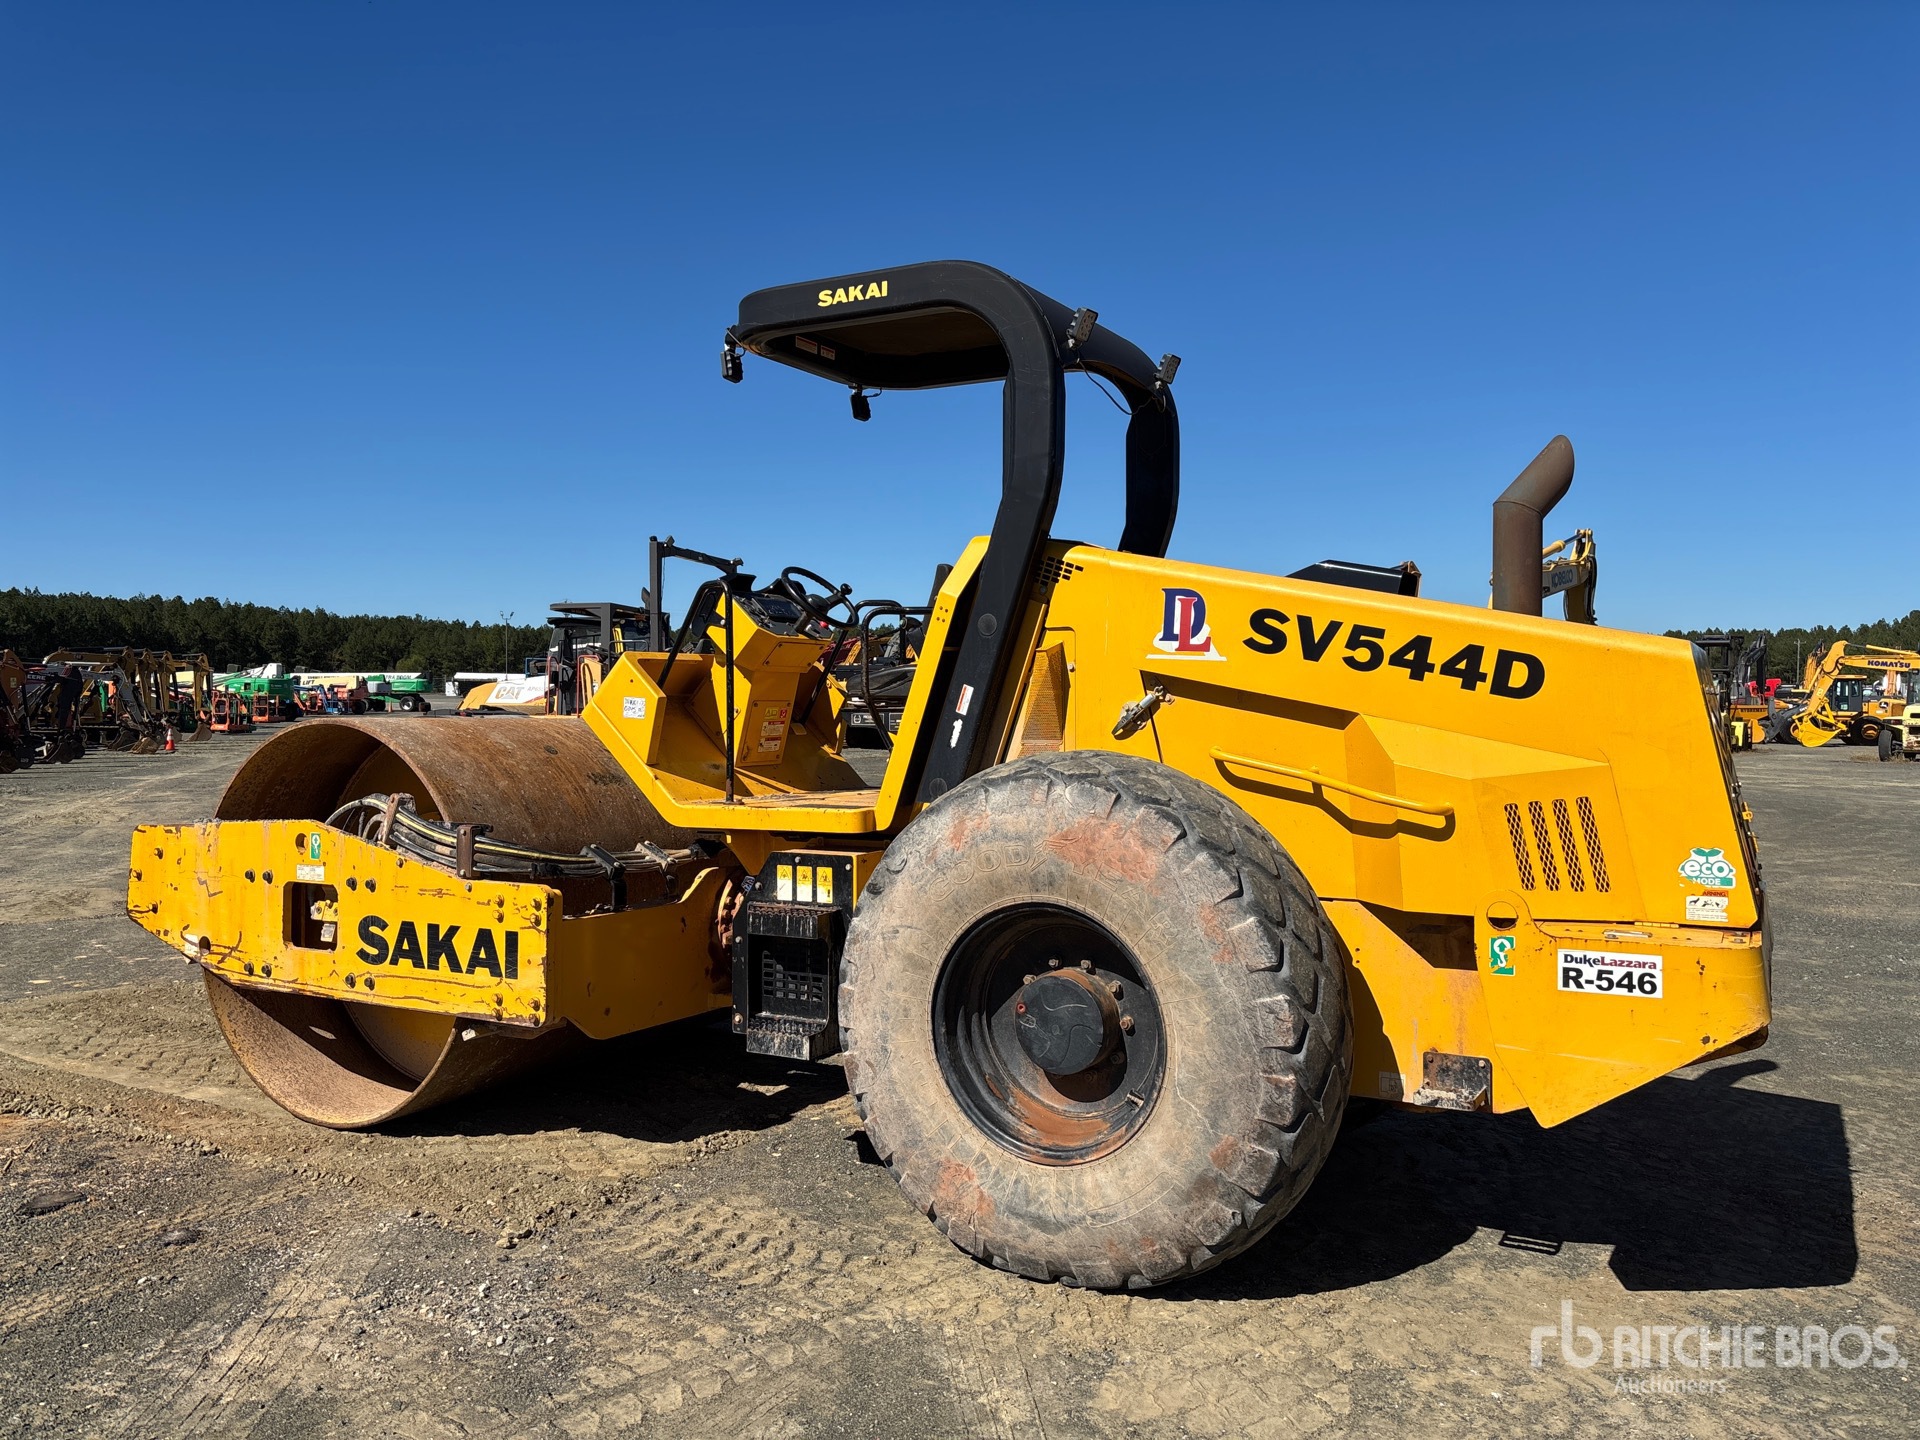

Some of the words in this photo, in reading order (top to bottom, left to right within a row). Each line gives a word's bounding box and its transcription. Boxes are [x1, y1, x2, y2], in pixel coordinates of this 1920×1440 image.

[817, 280, 889, 307] SAKAI
[1242, 608, 1546, 700] SV544D
[1867, 660, 1911, 668] KOMATSU
[495, 686, 525, 701] CAT
[1683, 860, 1731, 878] eco
[356, 915, 519, 980] SAKAI
[1562, 966, 1658, 995] R-546
